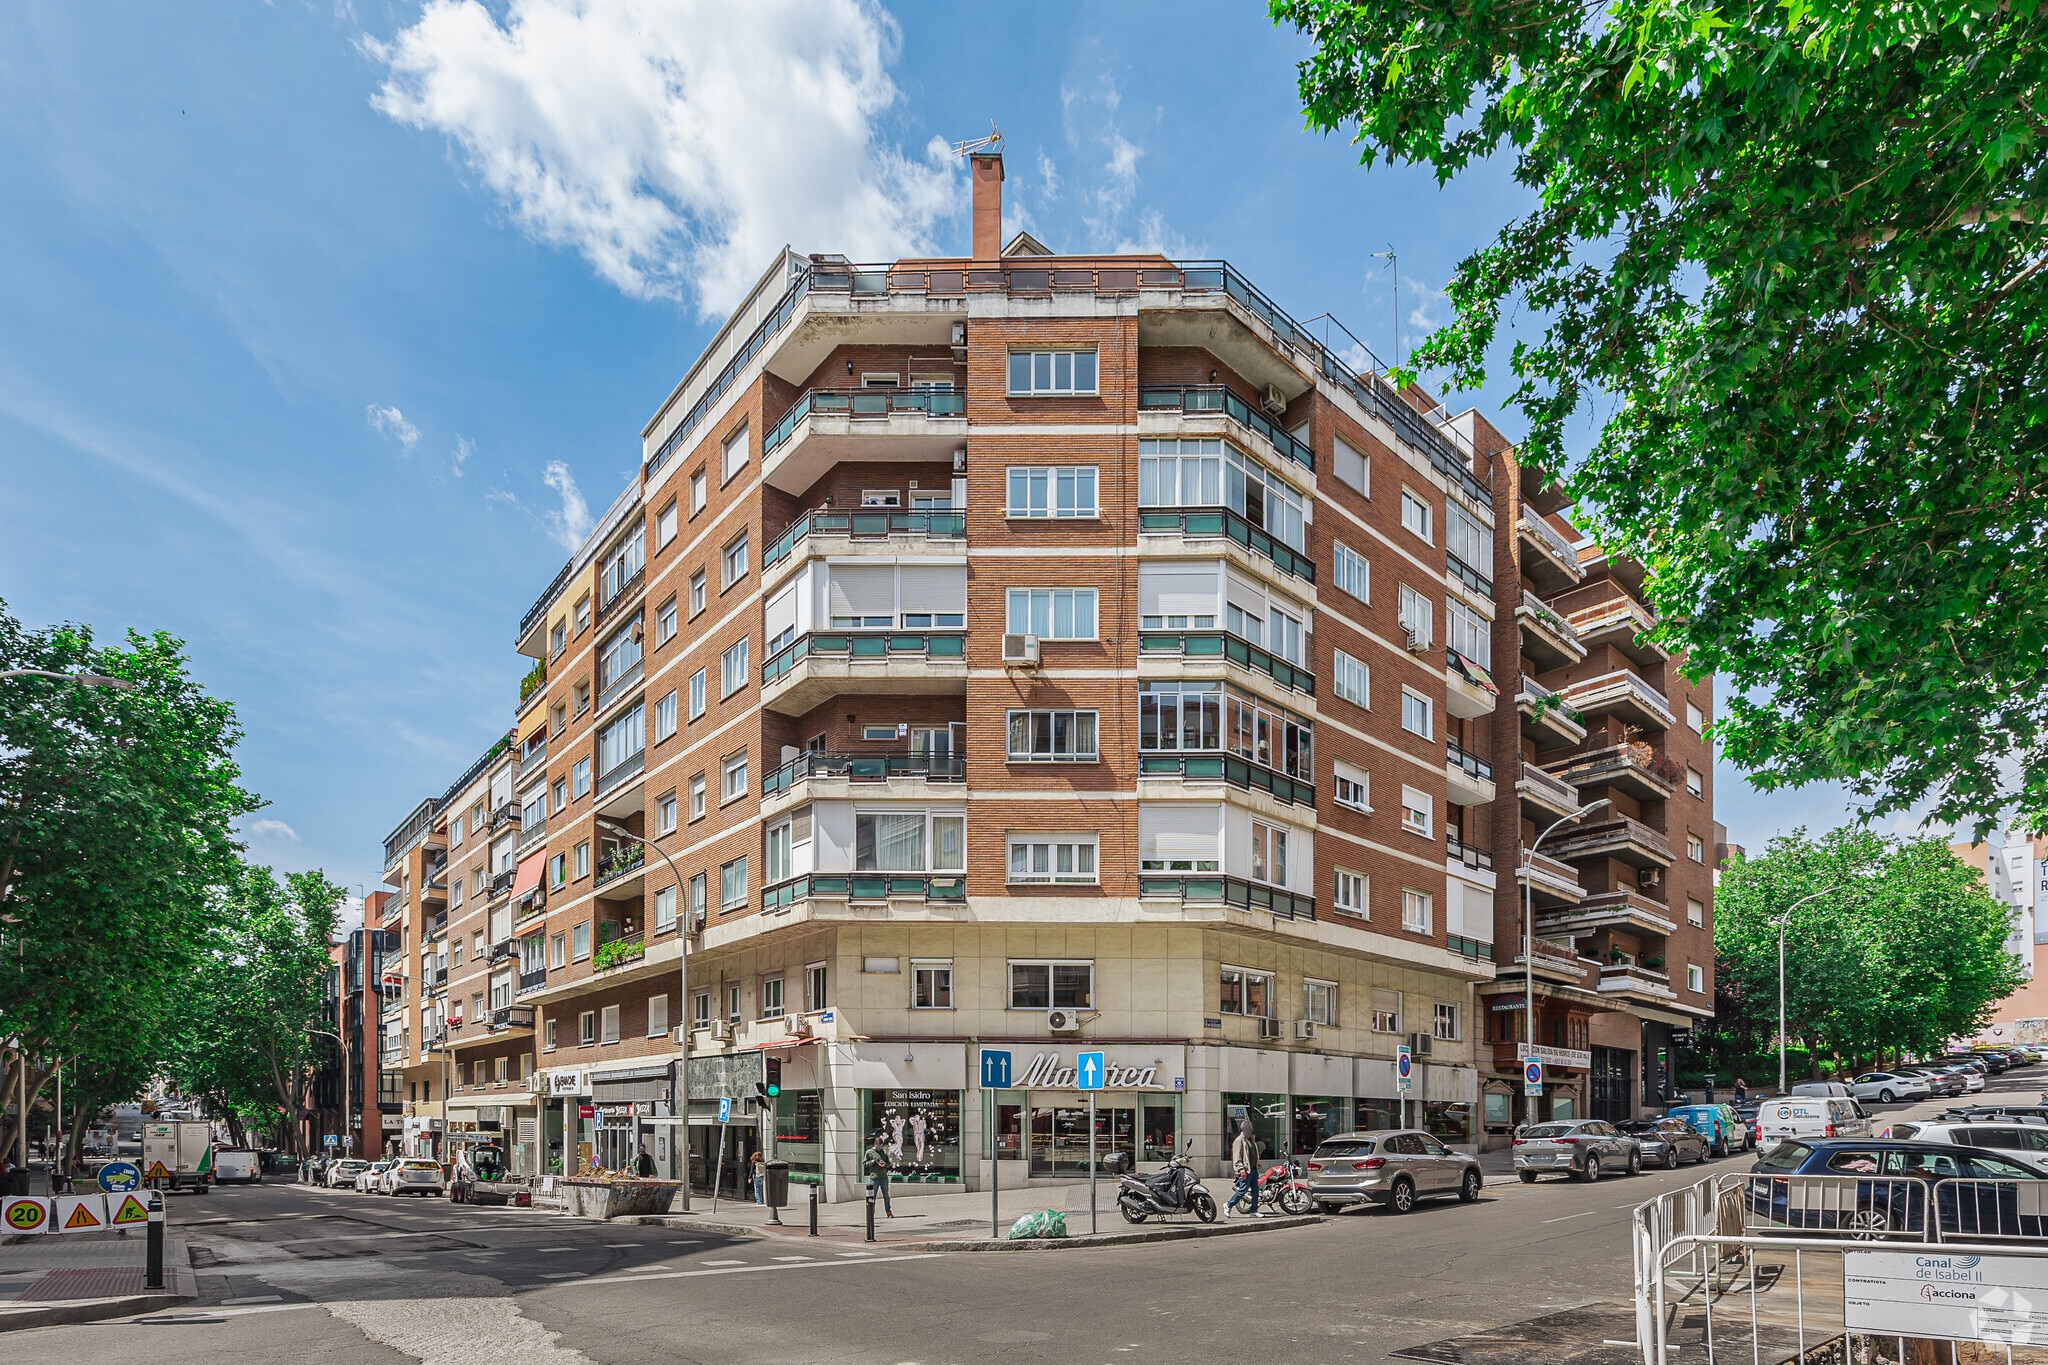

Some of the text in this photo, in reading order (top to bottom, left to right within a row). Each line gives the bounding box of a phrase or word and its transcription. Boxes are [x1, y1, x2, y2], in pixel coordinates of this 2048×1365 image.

[1012, 1052, 1165, 1090] Marca
[892, 1091, 931, 1100] San Isidro
[13, 1208, 39, 1222] 20
[1916, 1256, 1952, 1268] Canal
[1916, 1267, 1983, 1282] de Isabel II
